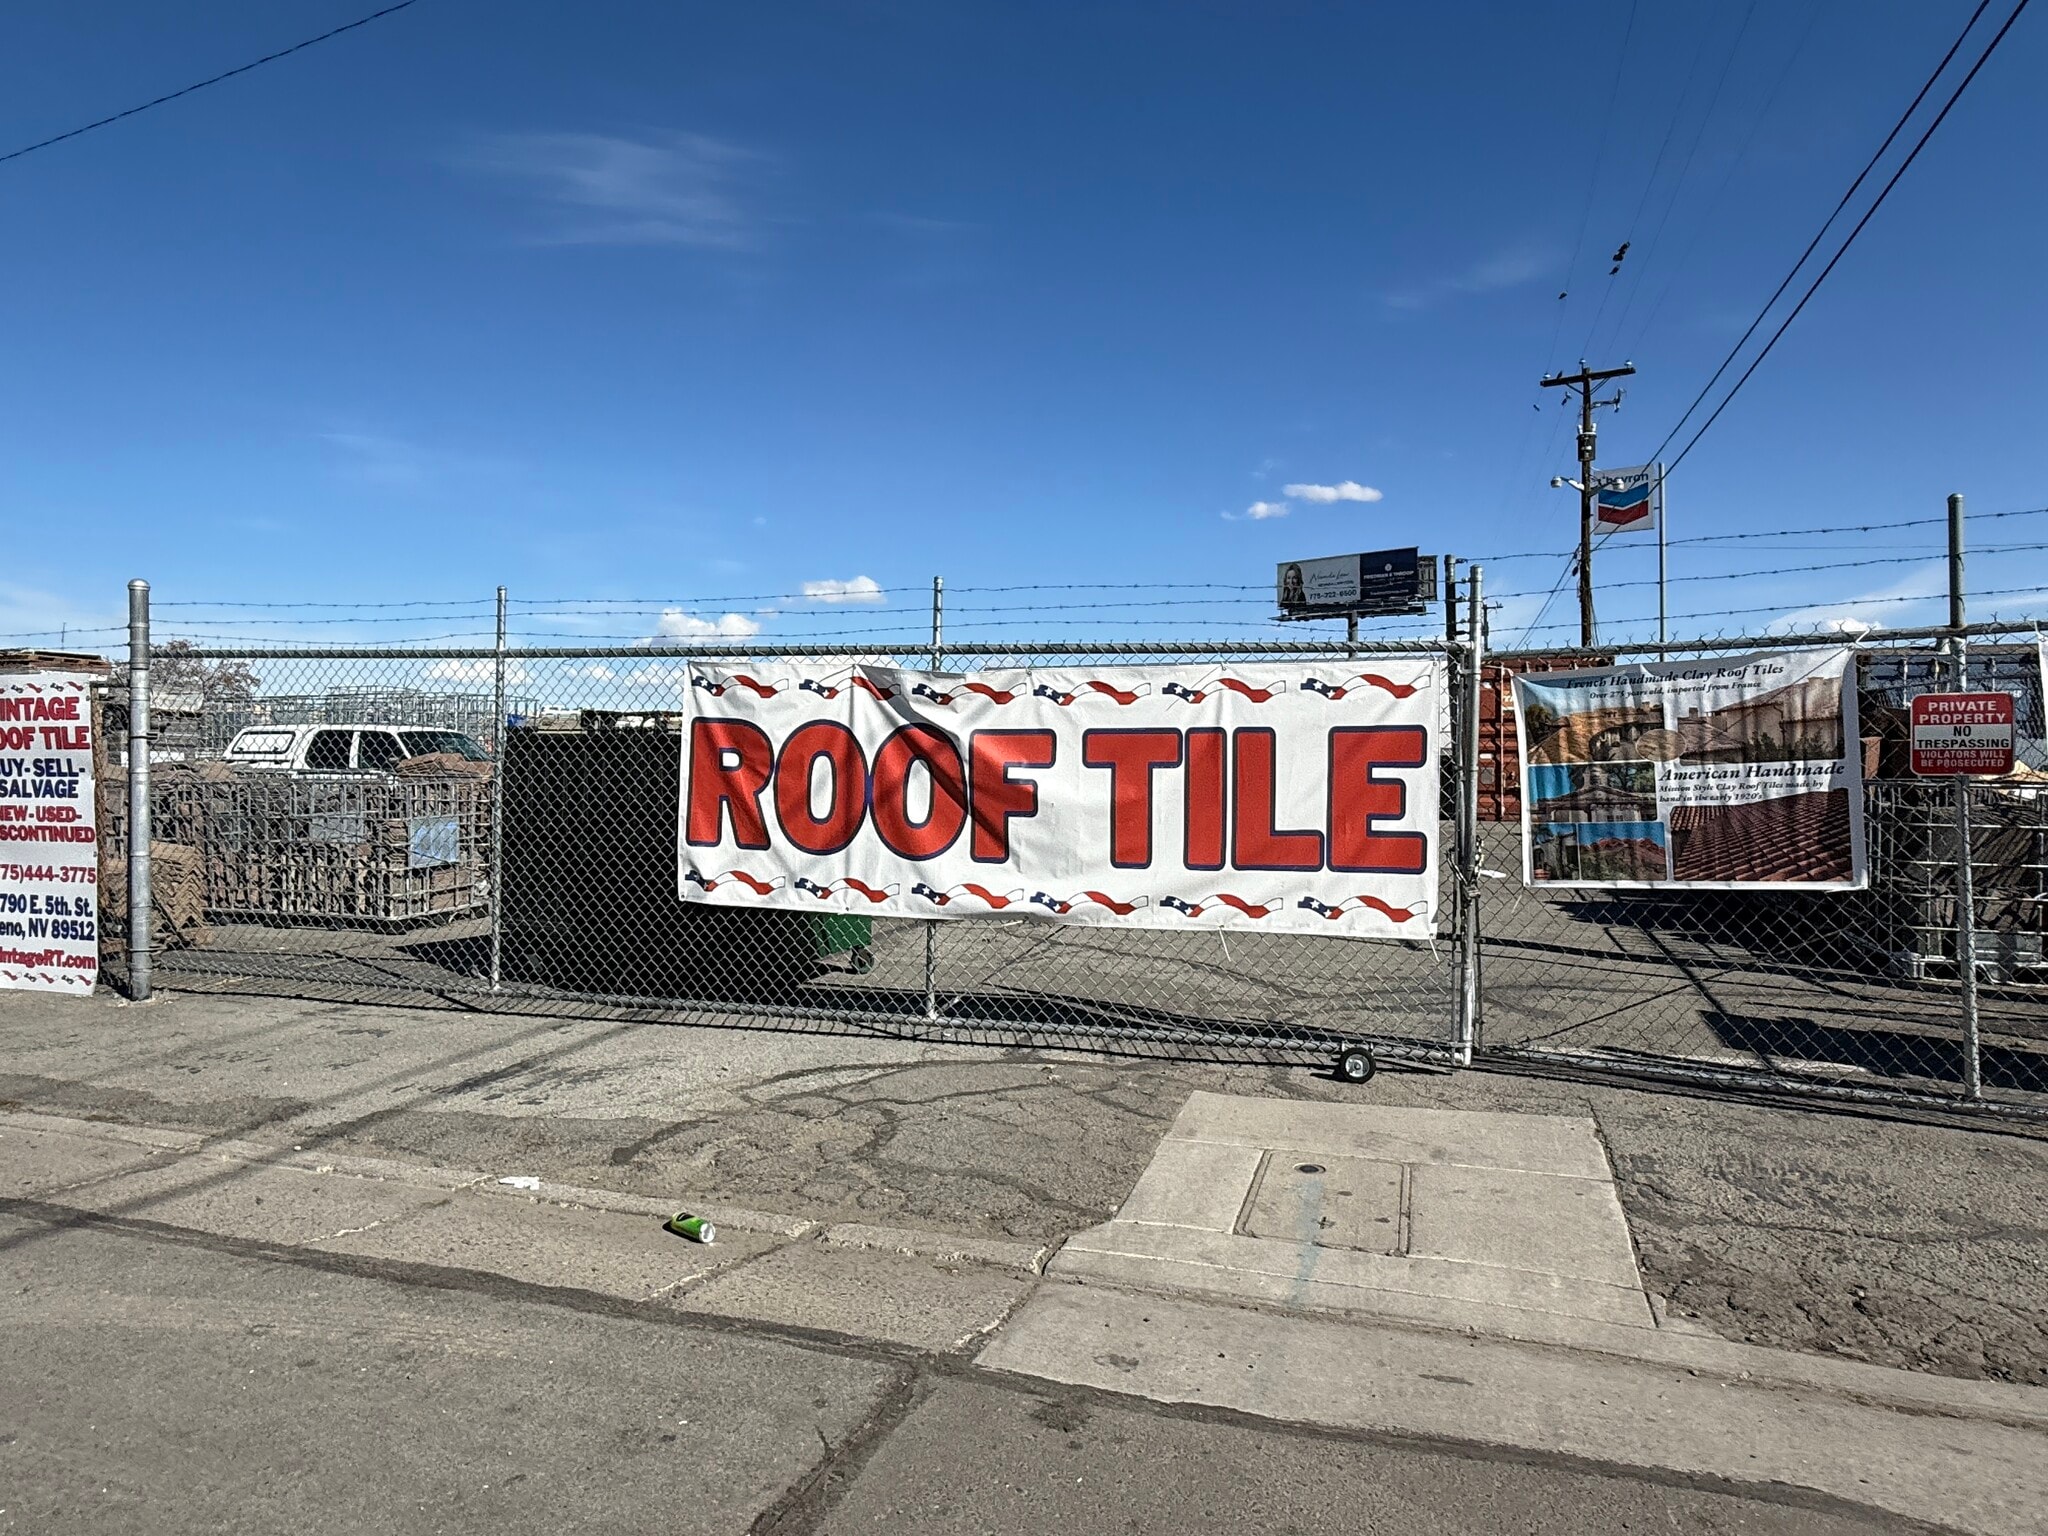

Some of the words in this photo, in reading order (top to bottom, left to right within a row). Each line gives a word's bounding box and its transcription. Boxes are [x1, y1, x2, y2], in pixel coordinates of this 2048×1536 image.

[1567, 677, 1606, 689] French
[1610, 671, 1678, 686] Handmade
[1682, 669, 1713, 683] Clay
[1716, 665, 1750, 680] Roof
[1753, 664, 1784, 675] Tiles
[1627, 689, 1647, 699] years
[1667, 684, 1705, 695] imported
[1707, 683, 1729, 693] from
[1731, 682, 1761, 690] France
[0, 696, 80, 721] INTAGE
[1928, 701, 1997, 712] PRIVATE
[1919, 713, 2006, 724] PROPERTY
[39, 726, 90, 750] TILE
[1953, 725, 1972, 737] NO
[1916, 738, 2010, 749] TRESPASSING
[1920, 750, 1976, 759] VIOLATORS
[1980, 749, 2006, 758] WILL
[1921, 758, 1934, 767] BE
[1659, 767, 1740, 781] American
[1745, 761, 1845, 778] Handmade
[0, 779, 79, 798] SALVAGE
[1693, 784, 1713, 793] Style
[1716, 783, 1737, 791] Clay
[1738, 781, 1761, 791] Roof
[1762, 781, 1783, 789] Tiles
[1785, 780, 1810, 788] made
[1812, 779, 1824, 789] by
[685, 717, 1057, 864] ROOF
[1082, 725, 1427, 875] TILE
[1707, 793, 1732, 802] early
[0, 864, 96, 884] 75)444-3775
[0, 893, 27, 914] 790
[30, 895, 42, 914] E.
[45, 895, 72, 916] 5th.
[75, 897, 93, 917] St.
[0, 921, 25, 940] eno,
[28, 918, 49, 938] NV
[51, 919, 95, 941] 89512
